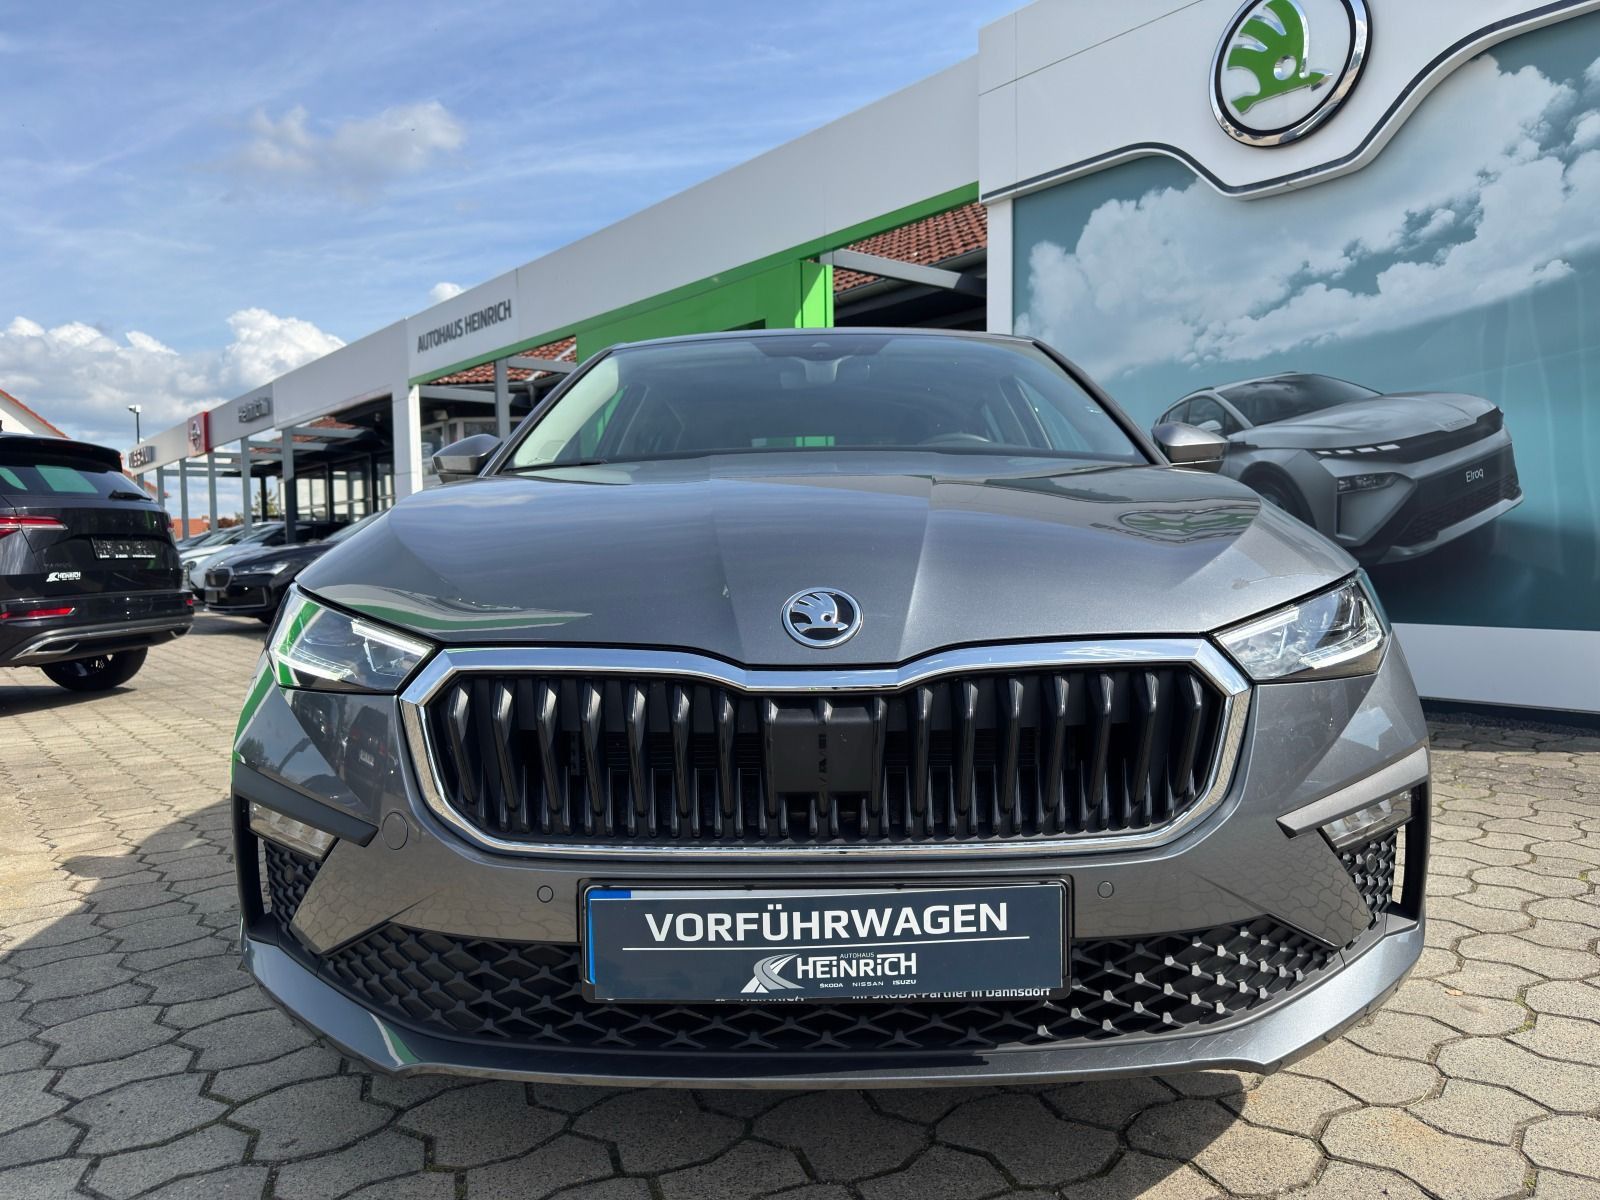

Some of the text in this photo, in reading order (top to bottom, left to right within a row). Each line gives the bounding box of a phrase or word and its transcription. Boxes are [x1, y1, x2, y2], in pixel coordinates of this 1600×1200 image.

[417, 299, 512, 354] AUTOHAUS HEINRICH
[1465, 468, 1484, 483] Elroq
[644, 902, 1008, 942] VORFÜHRWAGEN
